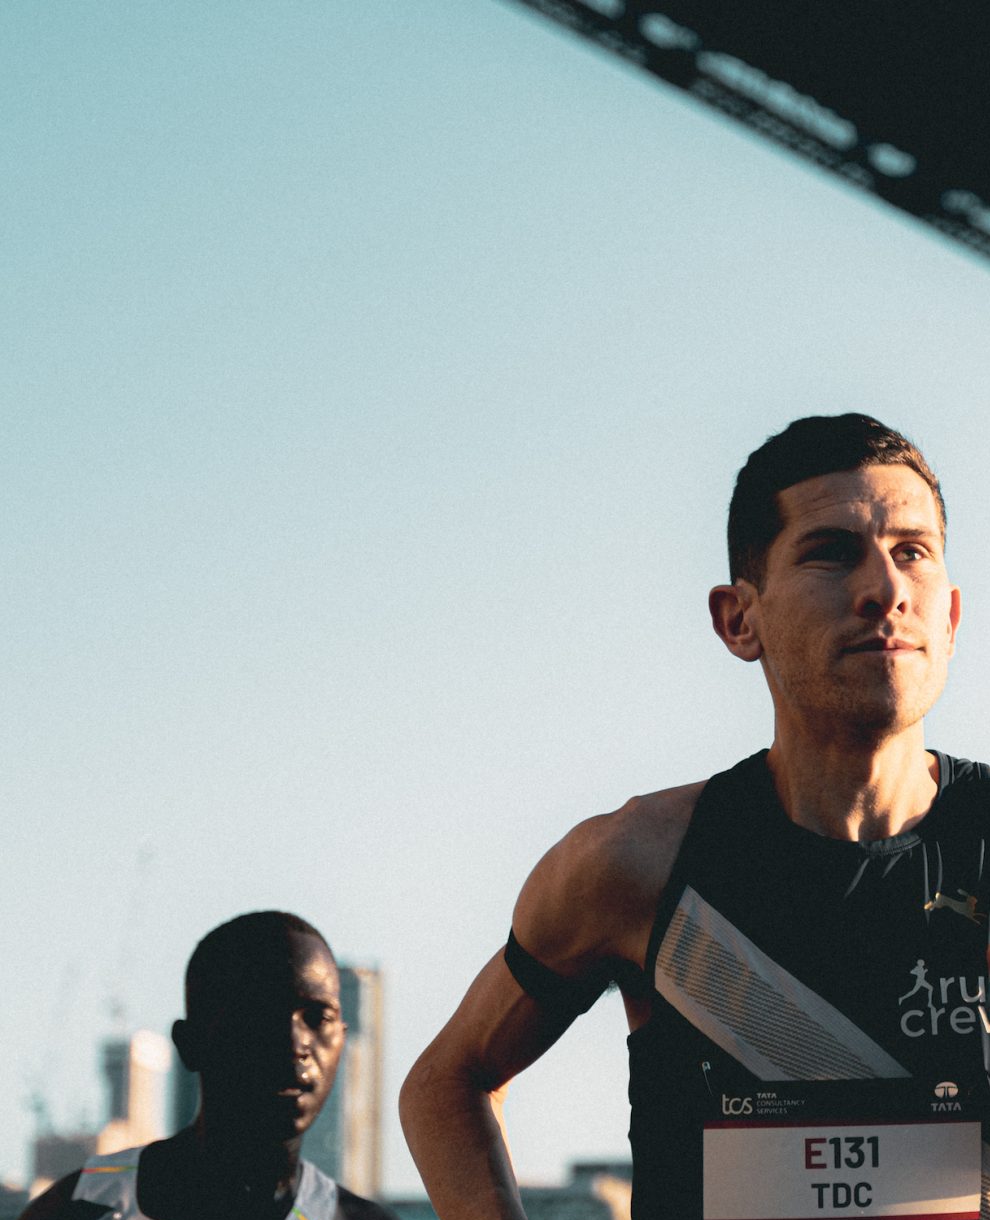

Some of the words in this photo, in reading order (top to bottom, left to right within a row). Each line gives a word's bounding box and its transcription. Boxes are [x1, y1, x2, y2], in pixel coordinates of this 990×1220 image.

[721, 1093, 753, 1115] tcs
[930, 1102, 962, 1112] TATA
[804, 1136, 880, 1170] E131
[811, 1182, 873, 1209] TDC
